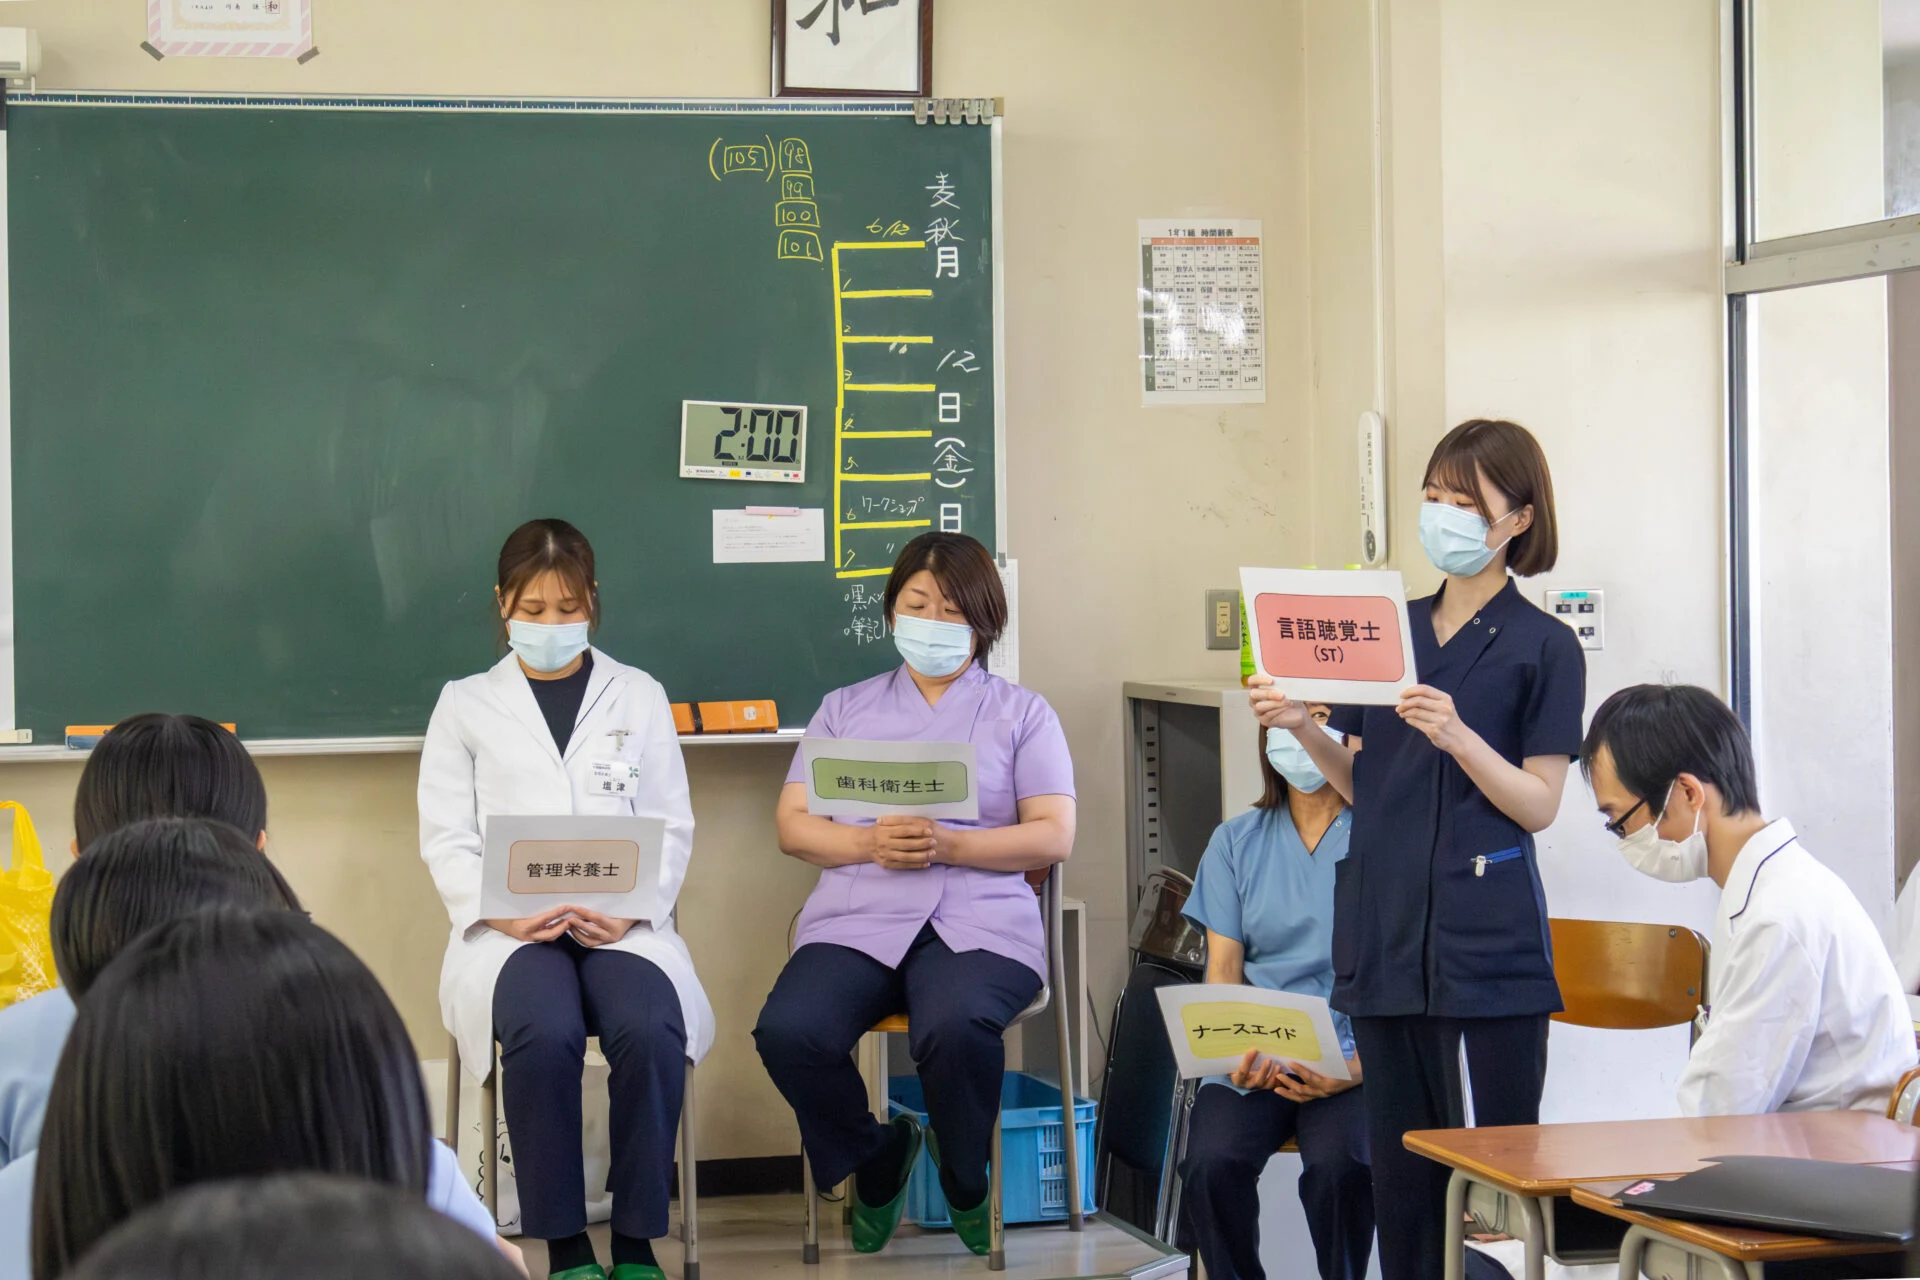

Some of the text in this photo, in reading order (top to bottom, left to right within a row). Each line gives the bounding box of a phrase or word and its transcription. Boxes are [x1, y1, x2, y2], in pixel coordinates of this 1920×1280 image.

[784, 141, 805, 169] 98
[782, 208, 811, 222] 100
[784, 238, 811, 257] 101
[714, 407, 800, 462] 2:00
[1277, 617, 1380, 642] 言語聴覚士
[1314, 645, 1344, 663] (ST)
[836, 776, 945, 793] 歯科衛生士
[526, 862, 620, 878] 管理栄養士
[1192, 1023, 1297, 1040] ナースエイド
